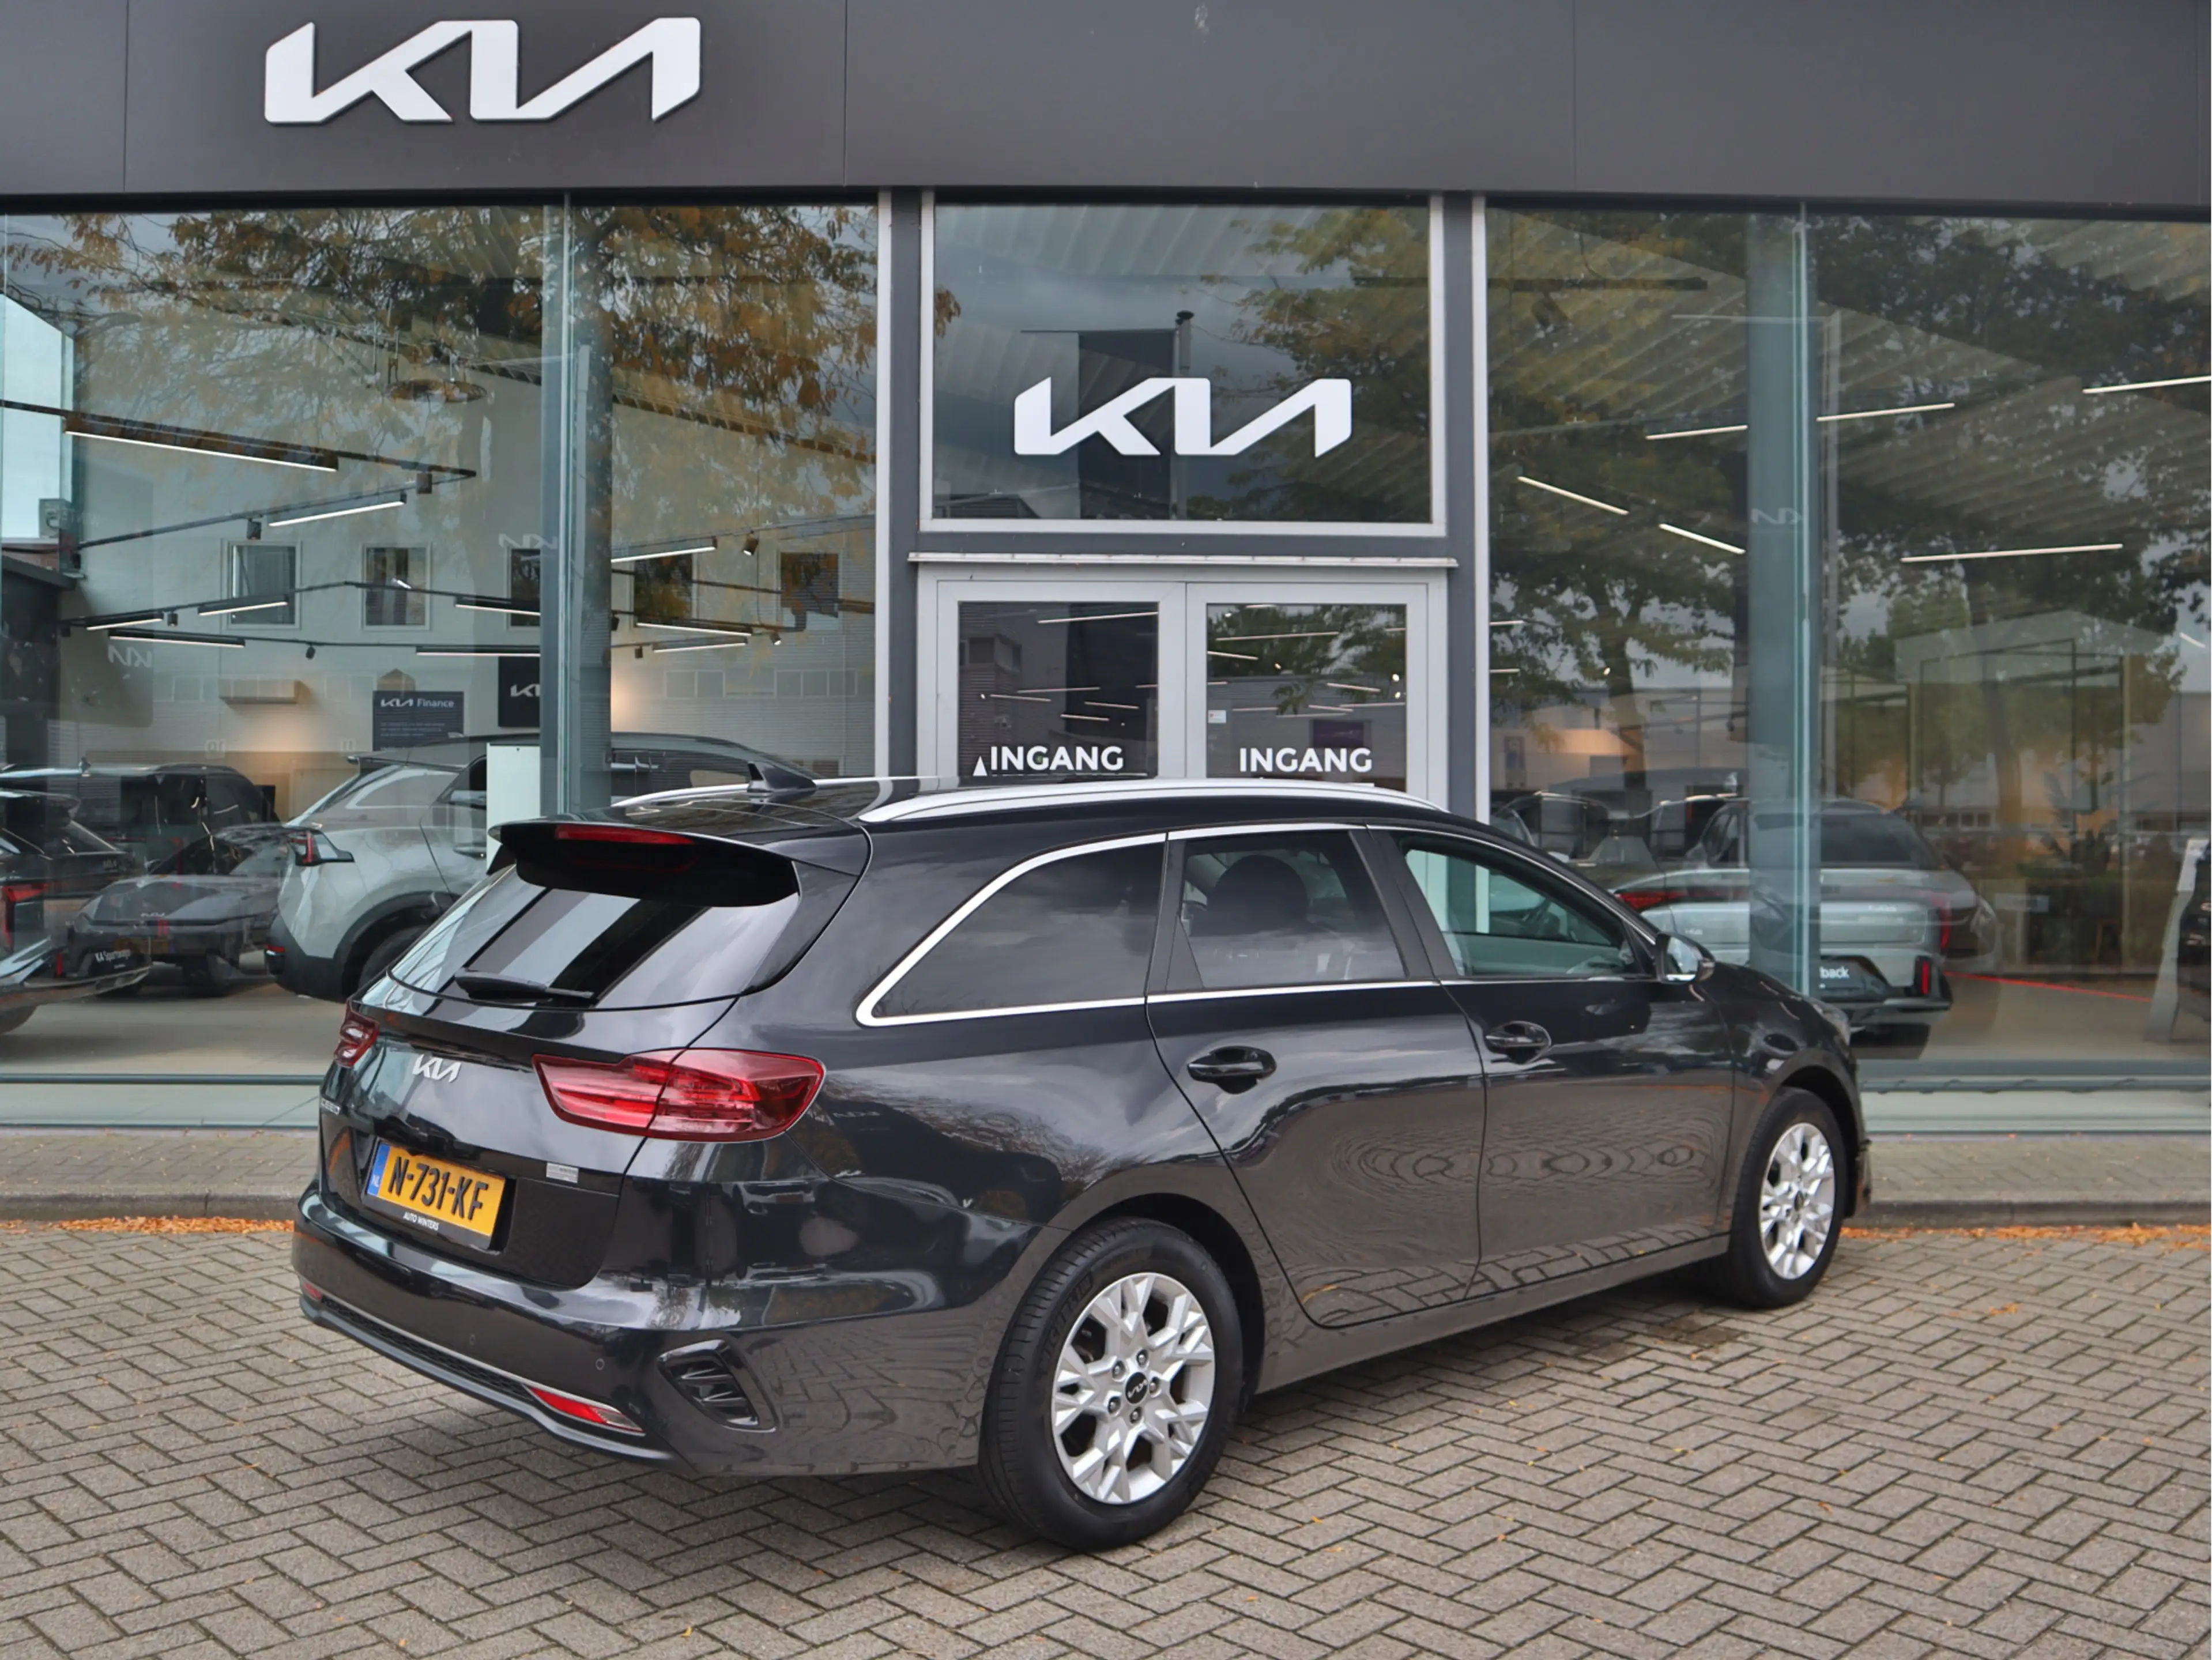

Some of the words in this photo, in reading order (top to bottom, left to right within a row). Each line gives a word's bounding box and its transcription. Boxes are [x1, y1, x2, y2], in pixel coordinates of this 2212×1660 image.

[265, 17, 700, 123] KIA
[1014, 376, 1352, 458] KIA
[380, 698, 413, 707] KIA
[417, 698, 454, 708] Finance
[510, 684, 540, 697] KI
[990, 746, 1124, 771] INGANG
[1240, 748, 1373, 773] INGANG
[412, 1054, 462, 1082] KIA
[387, 1156, 488, 1221] N-731-KF
[403, 1211, 417, 1223] AUTO
[417, 1215, 439, 1231] WINTERS
